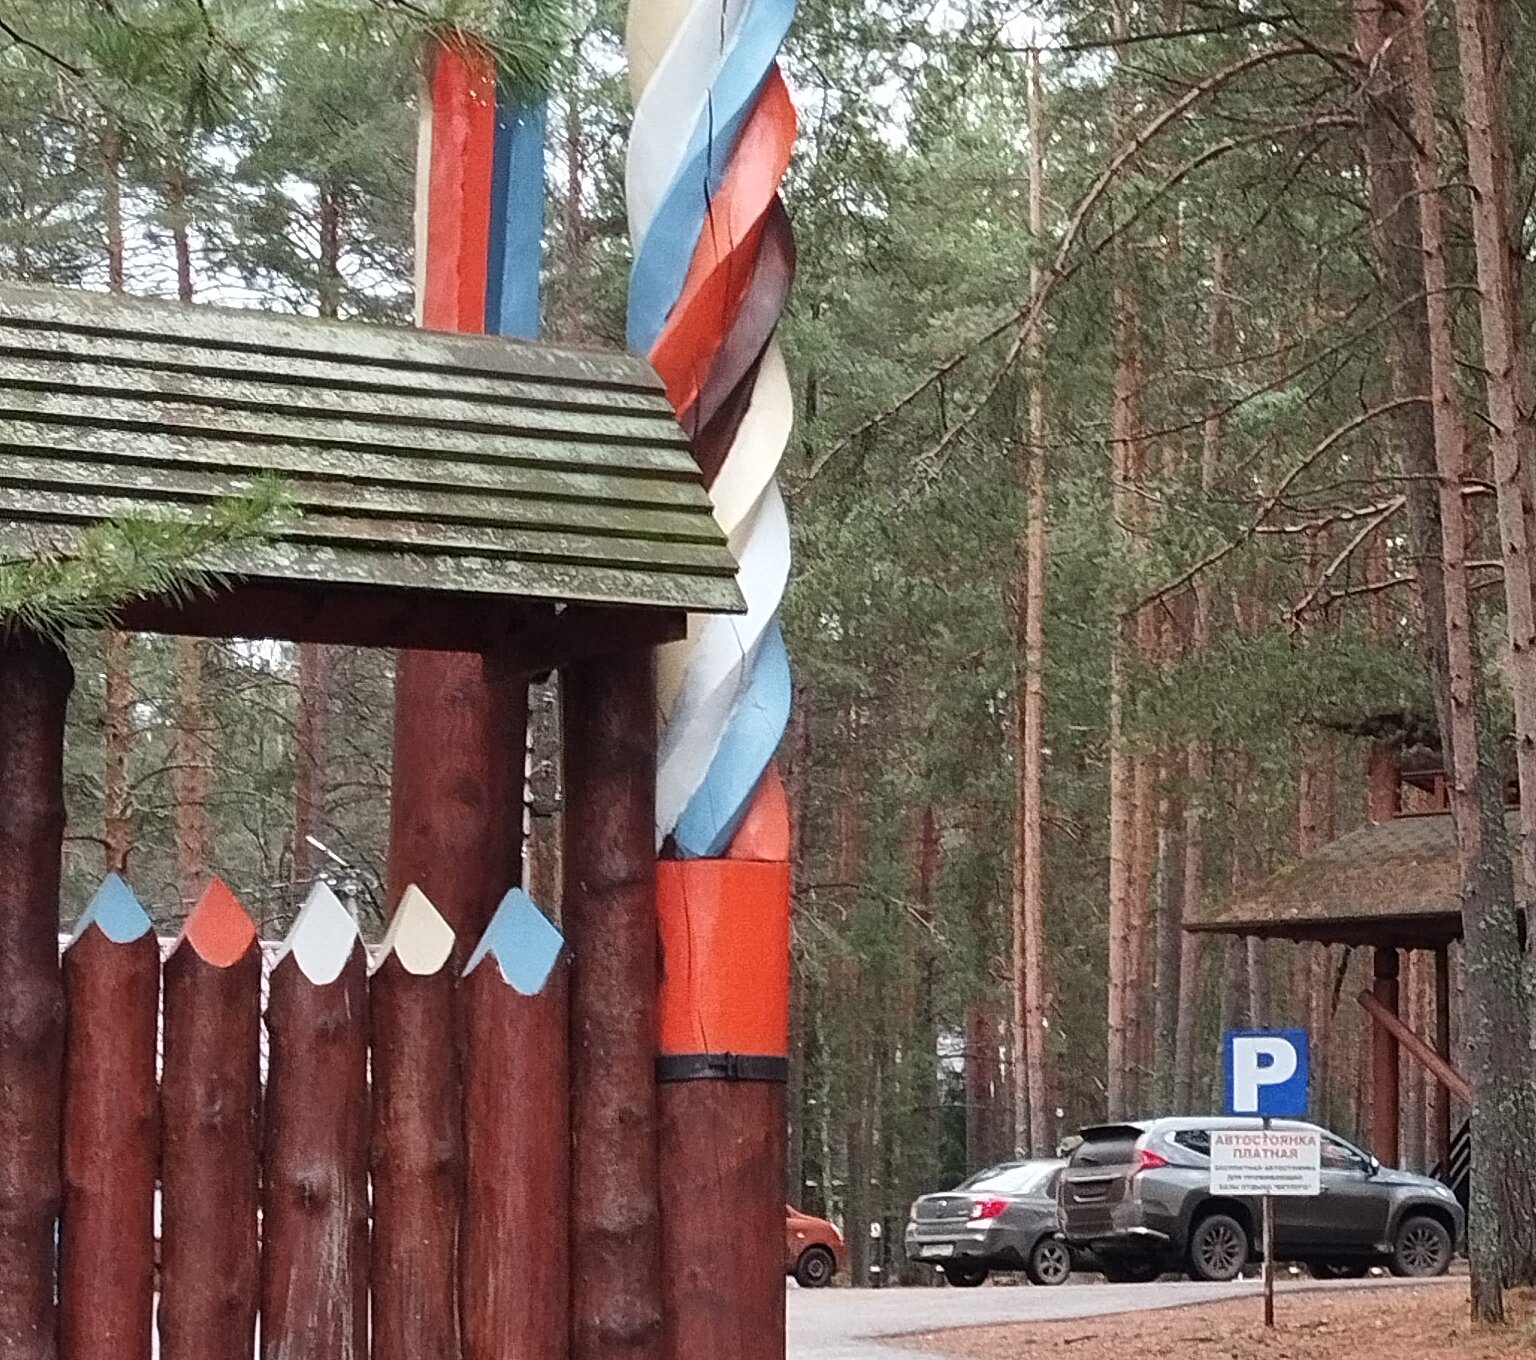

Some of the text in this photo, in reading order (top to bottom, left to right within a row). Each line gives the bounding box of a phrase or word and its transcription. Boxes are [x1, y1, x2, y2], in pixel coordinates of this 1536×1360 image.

[1232, 1036, 1298, 1113] P
[1215, 1134, 1317, 1146] АВТОСТОЯНКА
[1233, 1148, 1299, 1159] ПЛАТНАЯ
